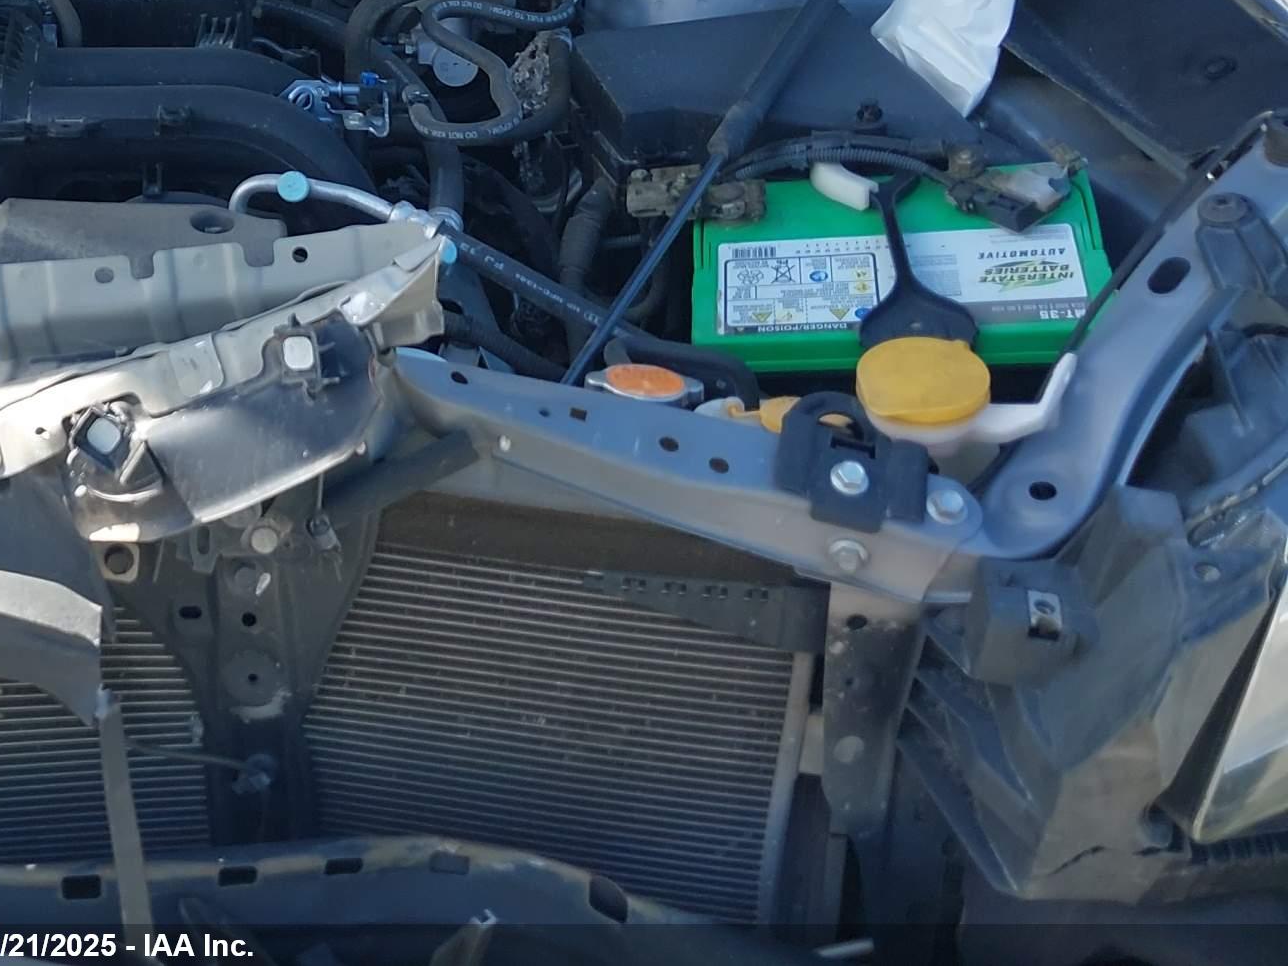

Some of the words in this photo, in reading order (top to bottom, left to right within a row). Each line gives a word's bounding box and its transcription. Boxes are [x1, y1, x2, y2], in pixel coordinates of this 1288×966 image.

[978, 247, 1066, 260] AUTOMOTIVE
[984, 264, 1070, 276] BATTERIES
[978, 272, 1075, 283] INTERSTATE
[757, 323, 848, 333] DANGER/POISON
